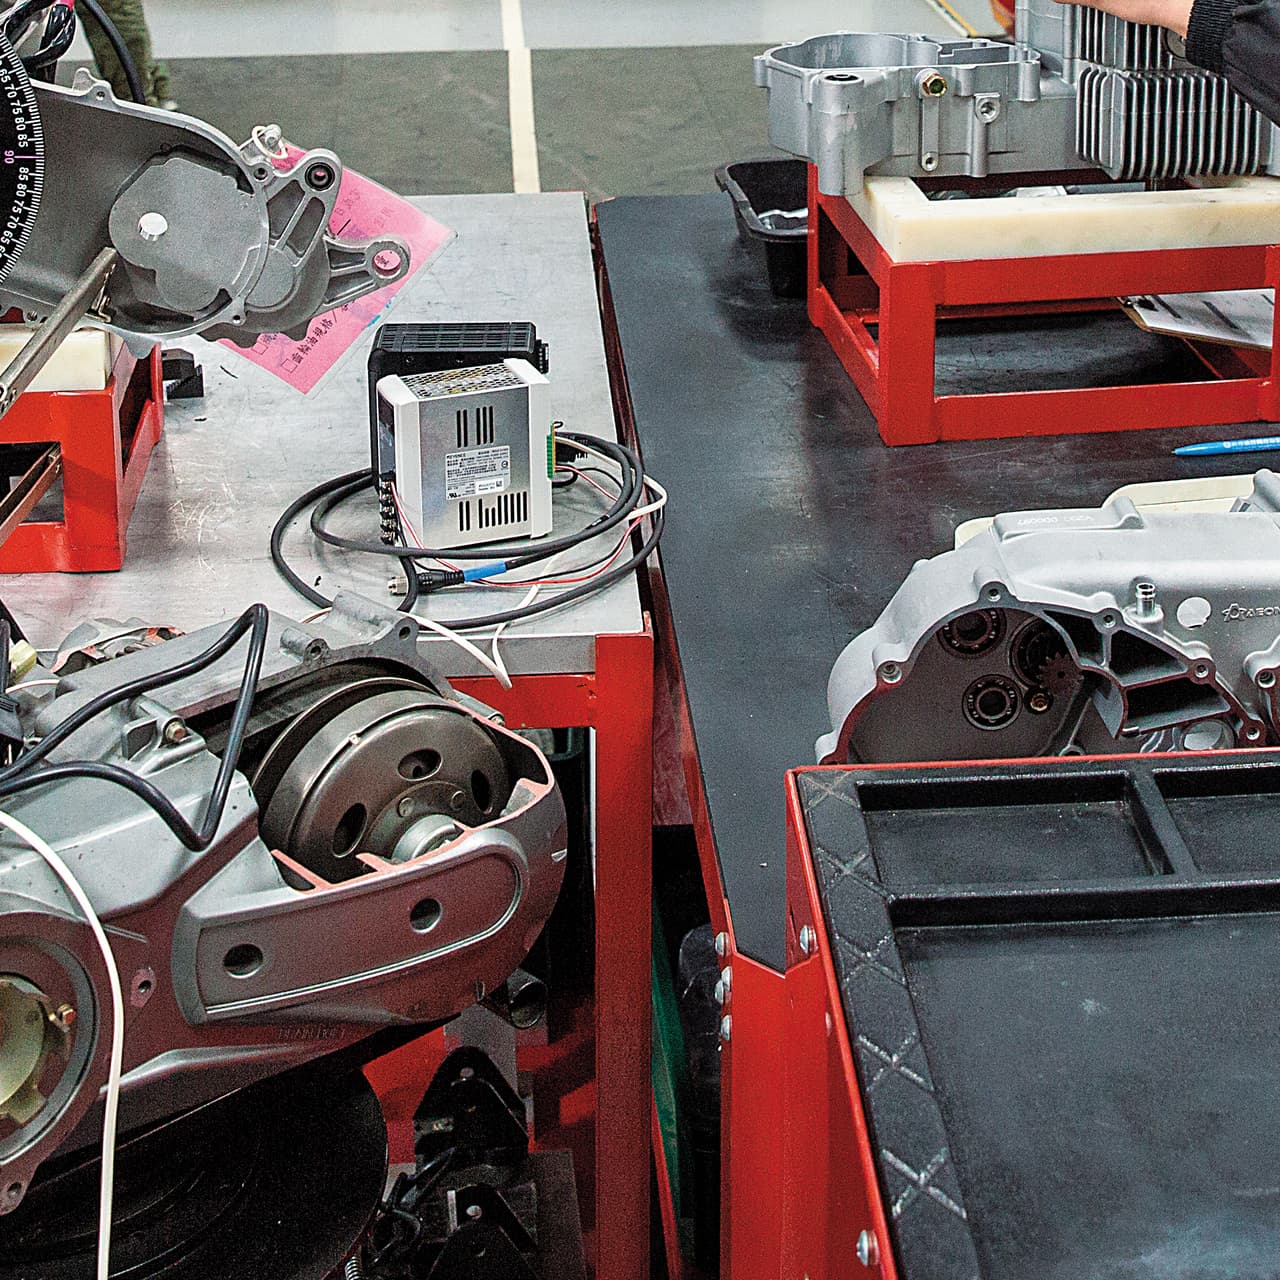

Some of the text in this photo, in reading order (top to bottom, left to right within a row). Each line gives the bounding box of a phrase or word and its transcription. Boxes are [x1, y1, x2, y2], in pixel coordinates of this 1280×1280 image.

[5, 83, 17, 98] 70
[11, 99, 22, 115] 75
[15, 116, 25, 131] 80
[18, 134, 27, 148] 85
[4, 149, 14, 164] 90
